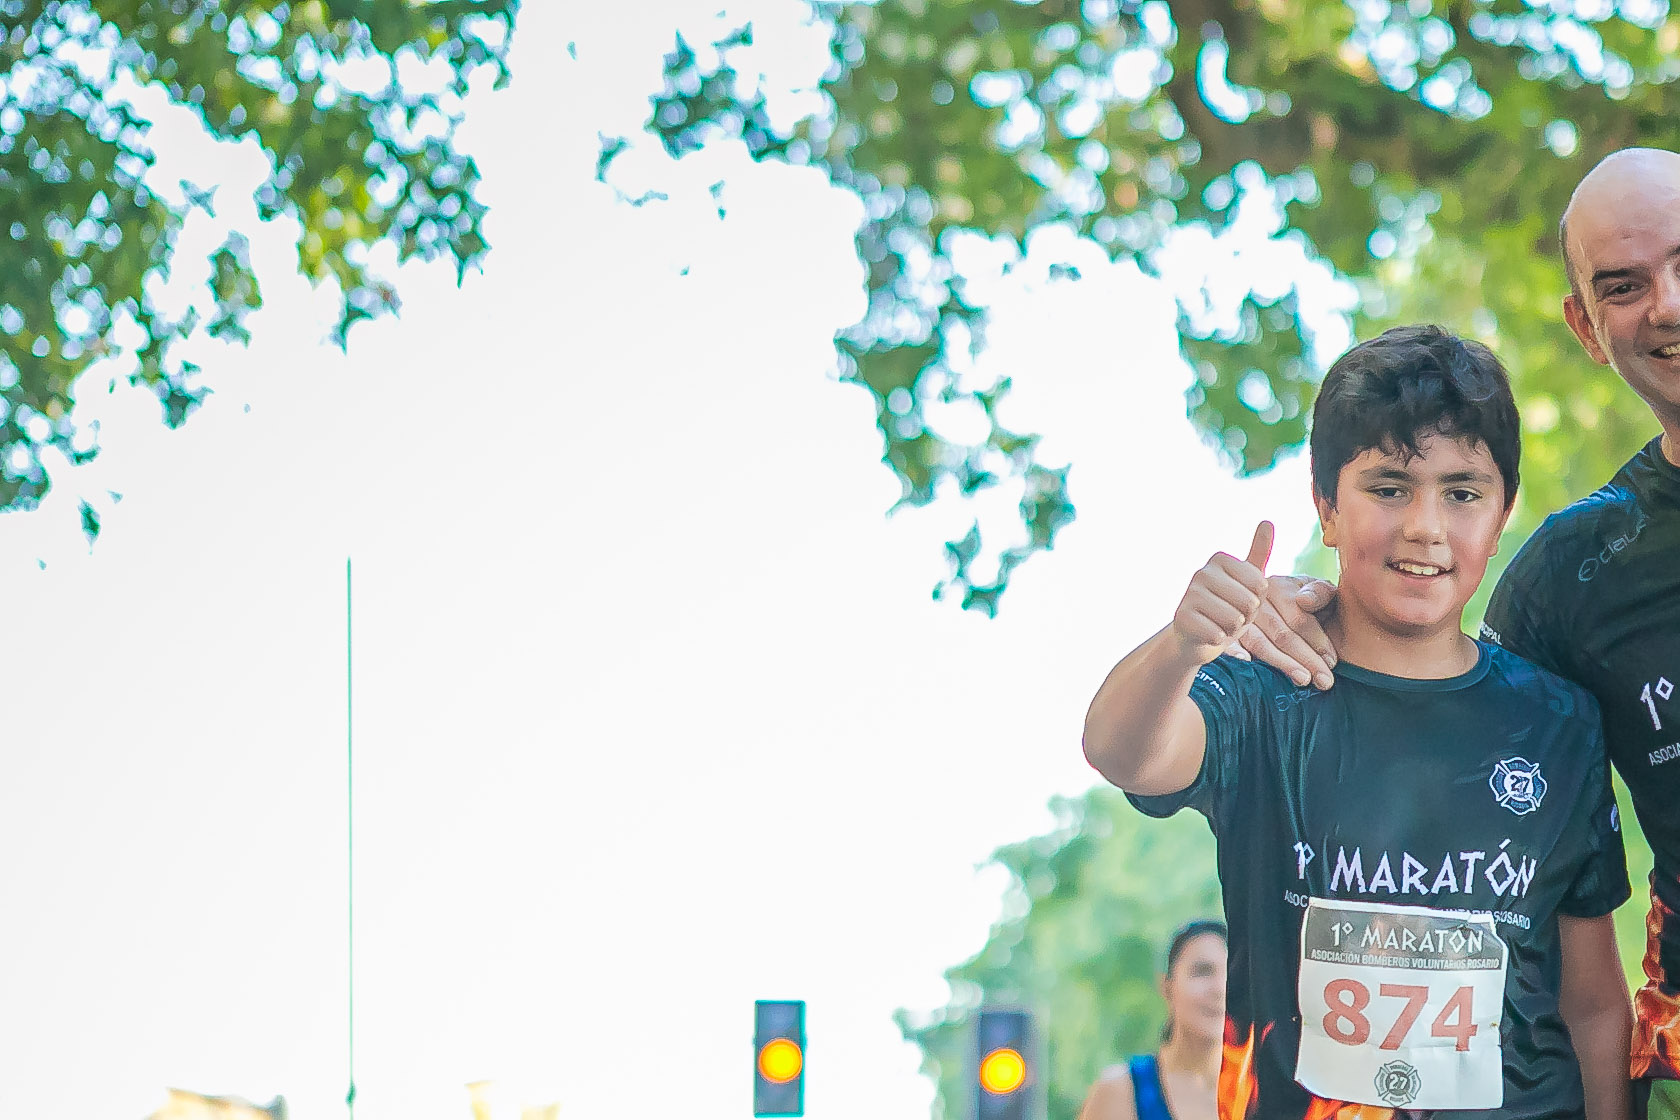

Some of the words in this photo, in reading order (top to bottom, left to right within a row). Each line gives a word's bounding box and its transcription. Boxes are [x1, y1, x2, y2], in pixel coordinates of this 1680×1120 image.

[1329, 838, 1537, 898] MARATÓN
[1360, 924, 1484, 953] MARATÓN
[1362, 954, 1410, 968] BOMBEROS
[1412, 957, 1467, 970] VOLUNTARIOS
[1467, 958, 1500, 970] ROSARIO
[1322, 978, 1478, 1052] 874
[1389, 1073, 1408, 1090] 27
